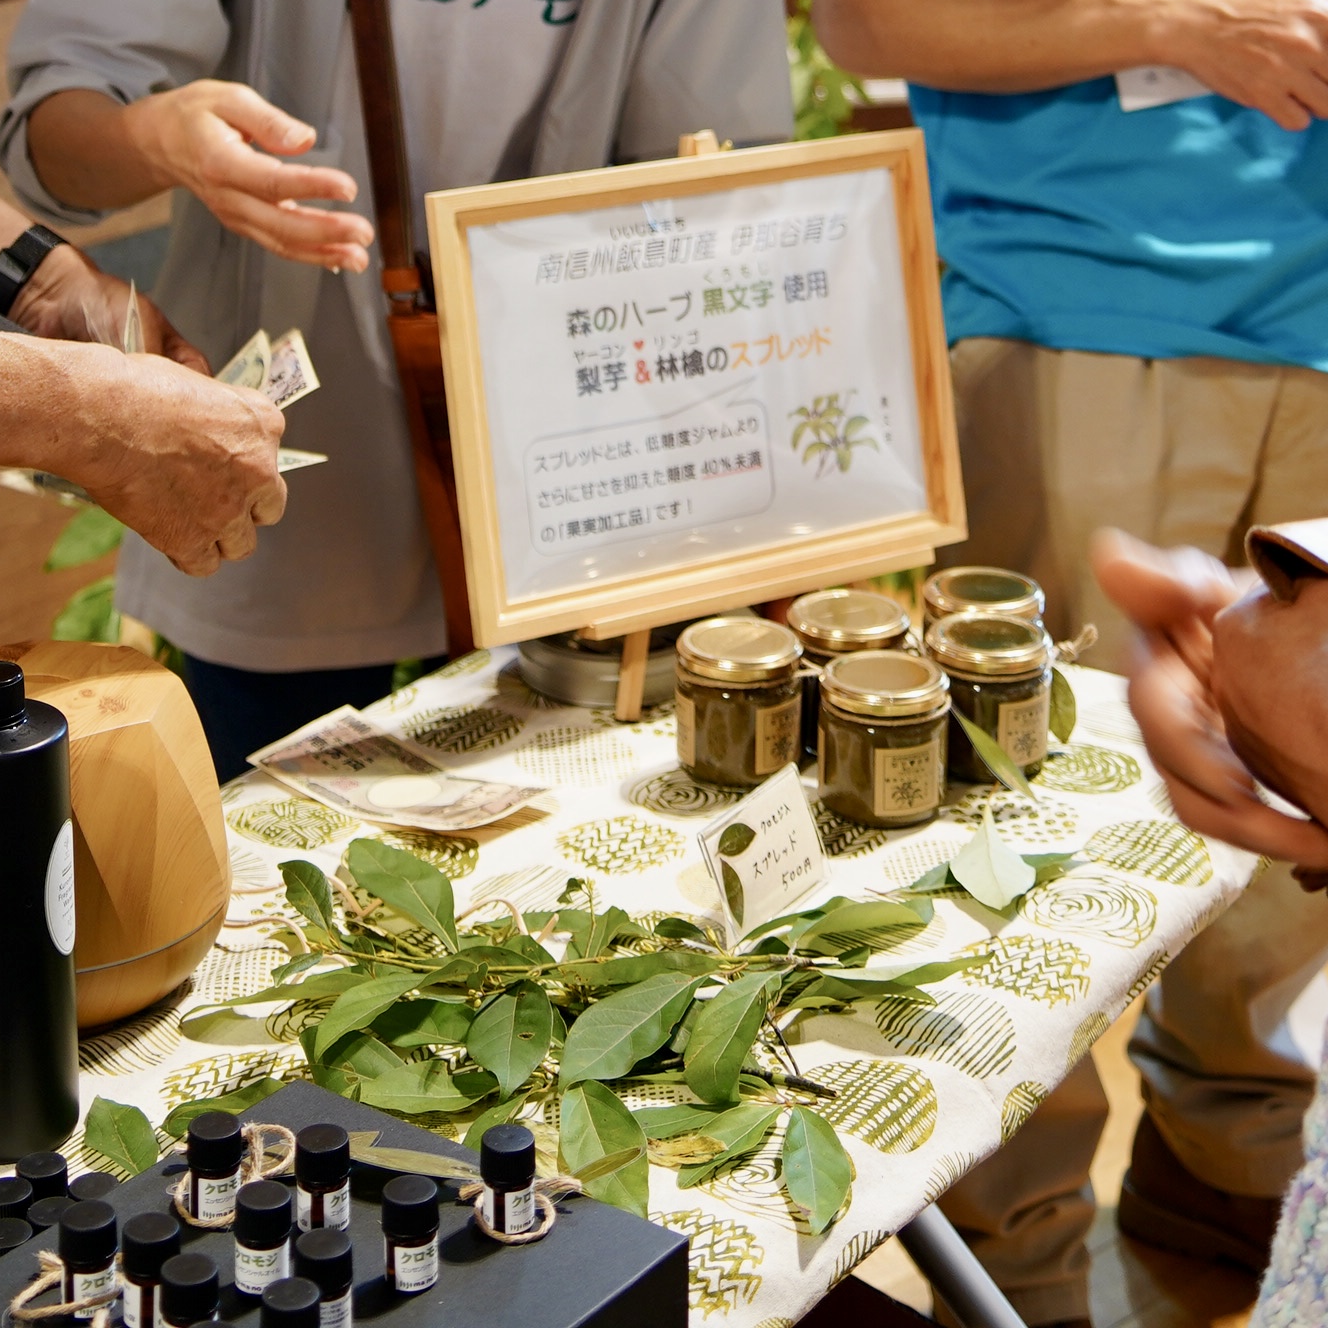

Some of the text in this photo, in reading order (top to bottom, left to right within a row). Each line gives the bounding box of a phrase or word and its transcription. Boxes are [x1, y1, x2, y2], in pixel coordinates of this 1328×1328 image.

[566, 270, 829, 339] 森のハーブ 黒文字 使用
[781, 857, 812, 892] 500円
